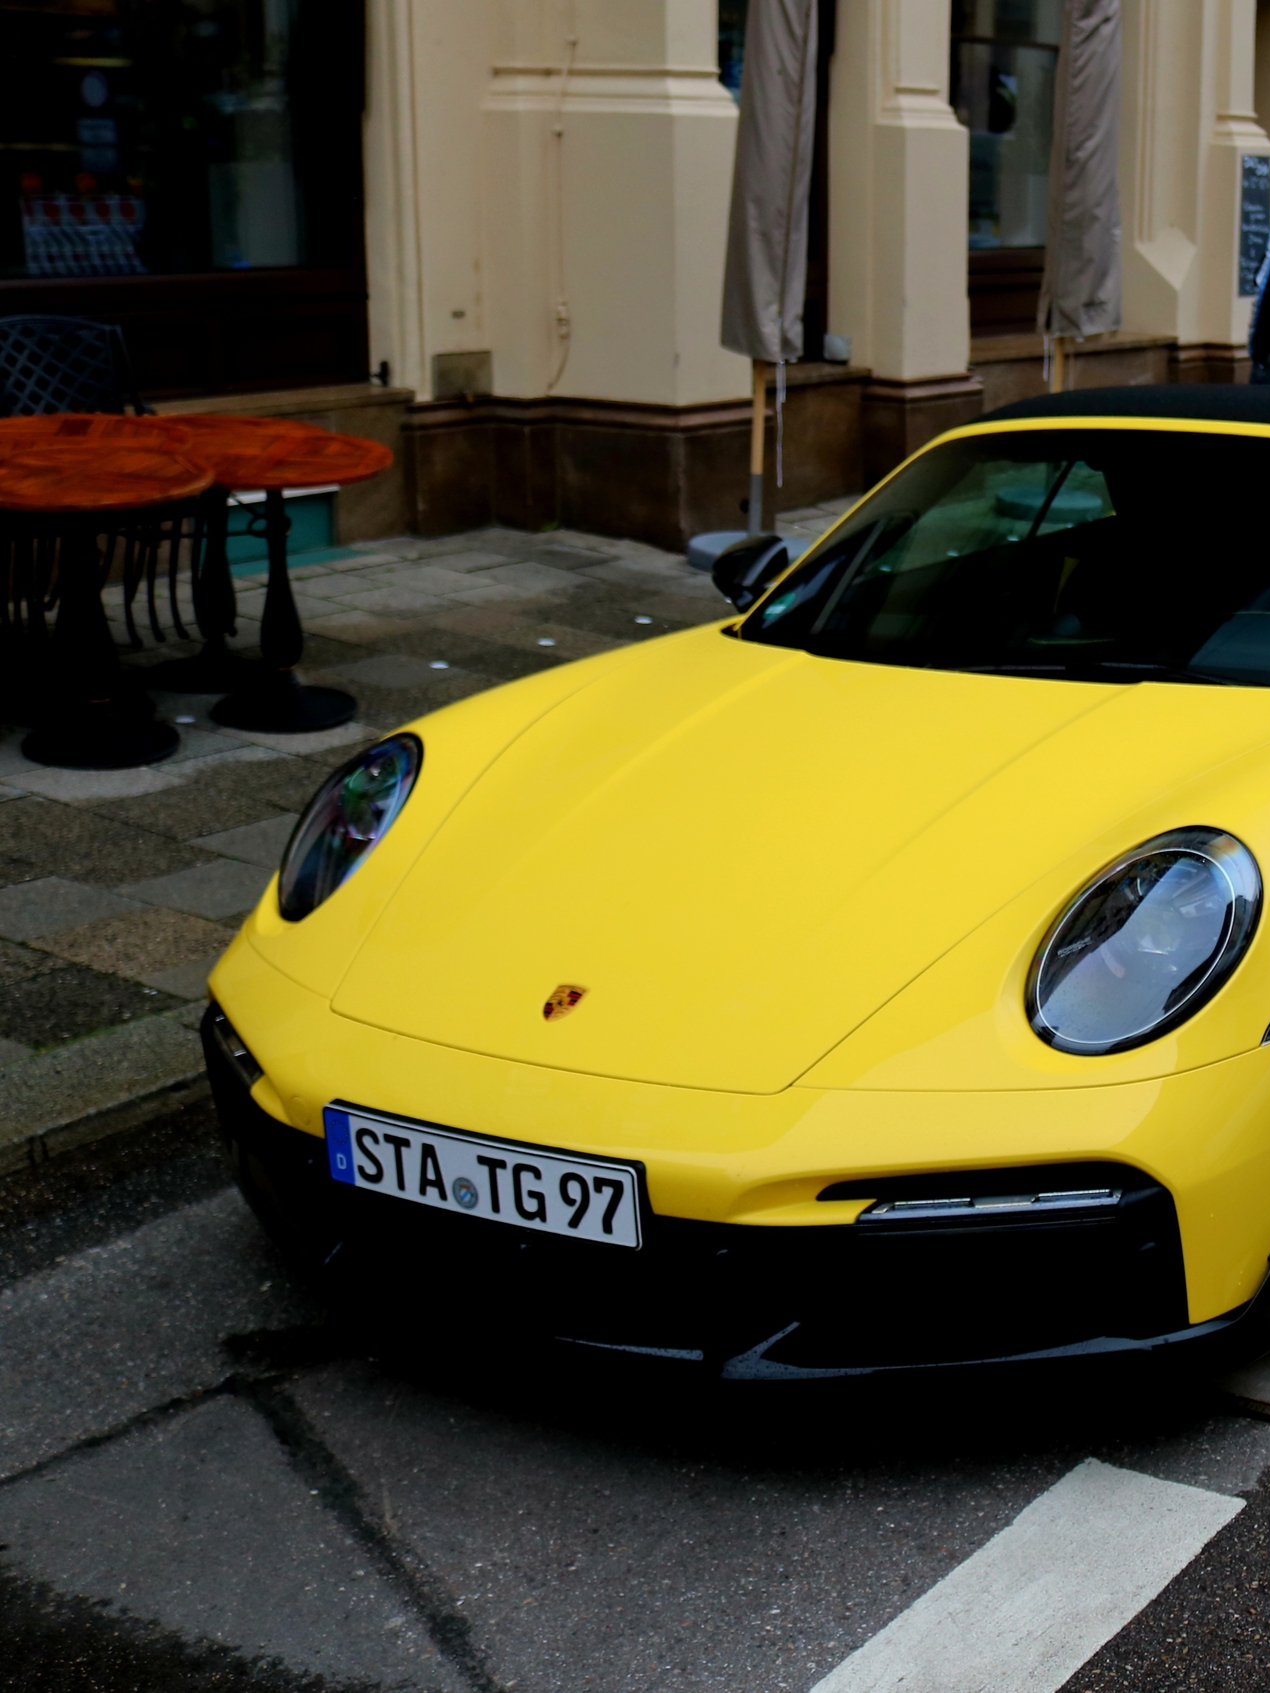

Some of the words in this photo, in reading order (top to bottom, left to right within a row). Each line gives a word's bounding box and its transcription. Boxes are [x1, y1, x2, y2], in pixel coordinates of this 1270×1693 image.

[336, 1153, 347, 1170] D
[355, 1127, 448, 1201] STA
[477, 1155, 547, 1223] TG
[559, 1172, 625, 1235] 97
